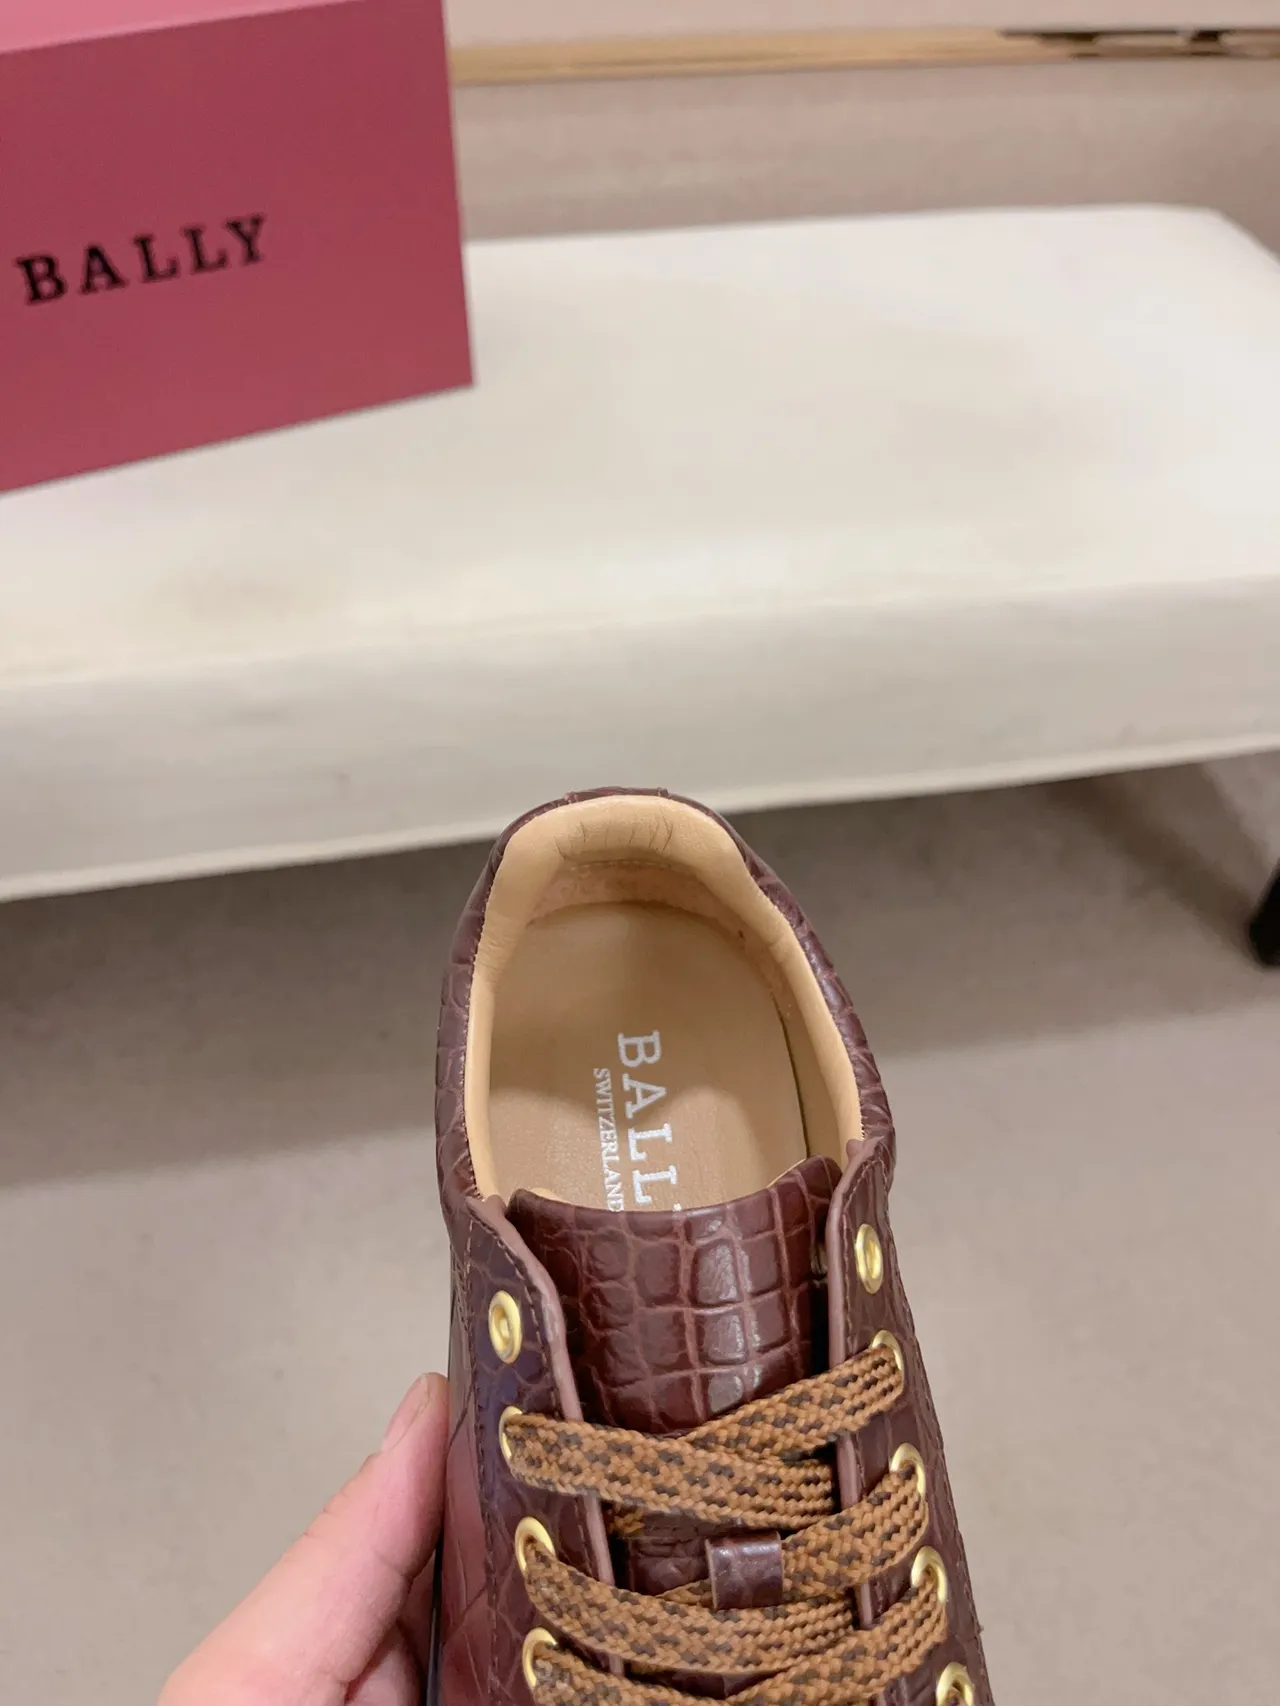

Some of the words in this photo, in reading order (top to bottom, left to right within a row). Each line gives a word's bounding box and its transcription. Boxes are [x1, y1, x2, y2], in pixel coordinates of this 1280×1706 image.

[14, 213, 265, 304] BALLY
[593, 1067, 625, 1212] SWITZERLAND
[617, 1029, 682, 1212] BALL
